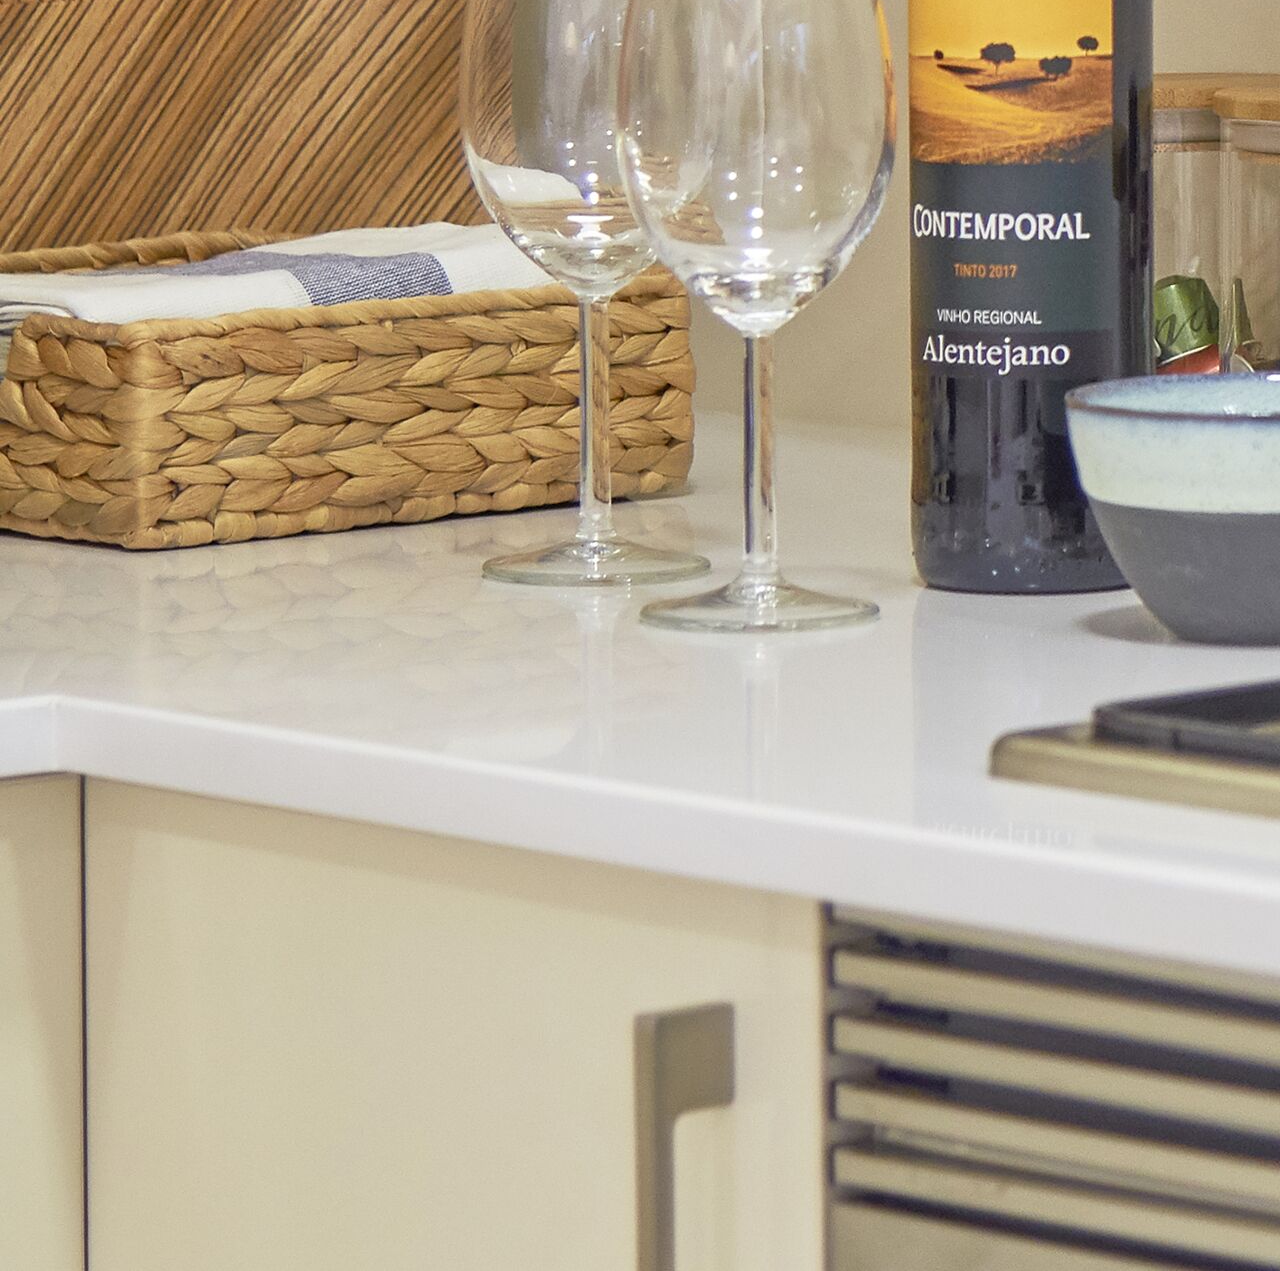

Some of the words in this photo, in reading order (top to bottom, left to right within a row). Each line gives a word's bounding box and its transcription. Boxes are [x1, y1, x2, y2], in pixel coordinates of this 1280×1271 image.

[913, 203, 1091, 241] CONTEMPORAL
[953, 264, 985, 278] TINTO
[989, 265, 1018, 278] 2017
[937, 309, 970, 323] VINHO
[974, 310, 1043, 325] REGIONAL
[923, 334, 1071, 375] Alentejano
